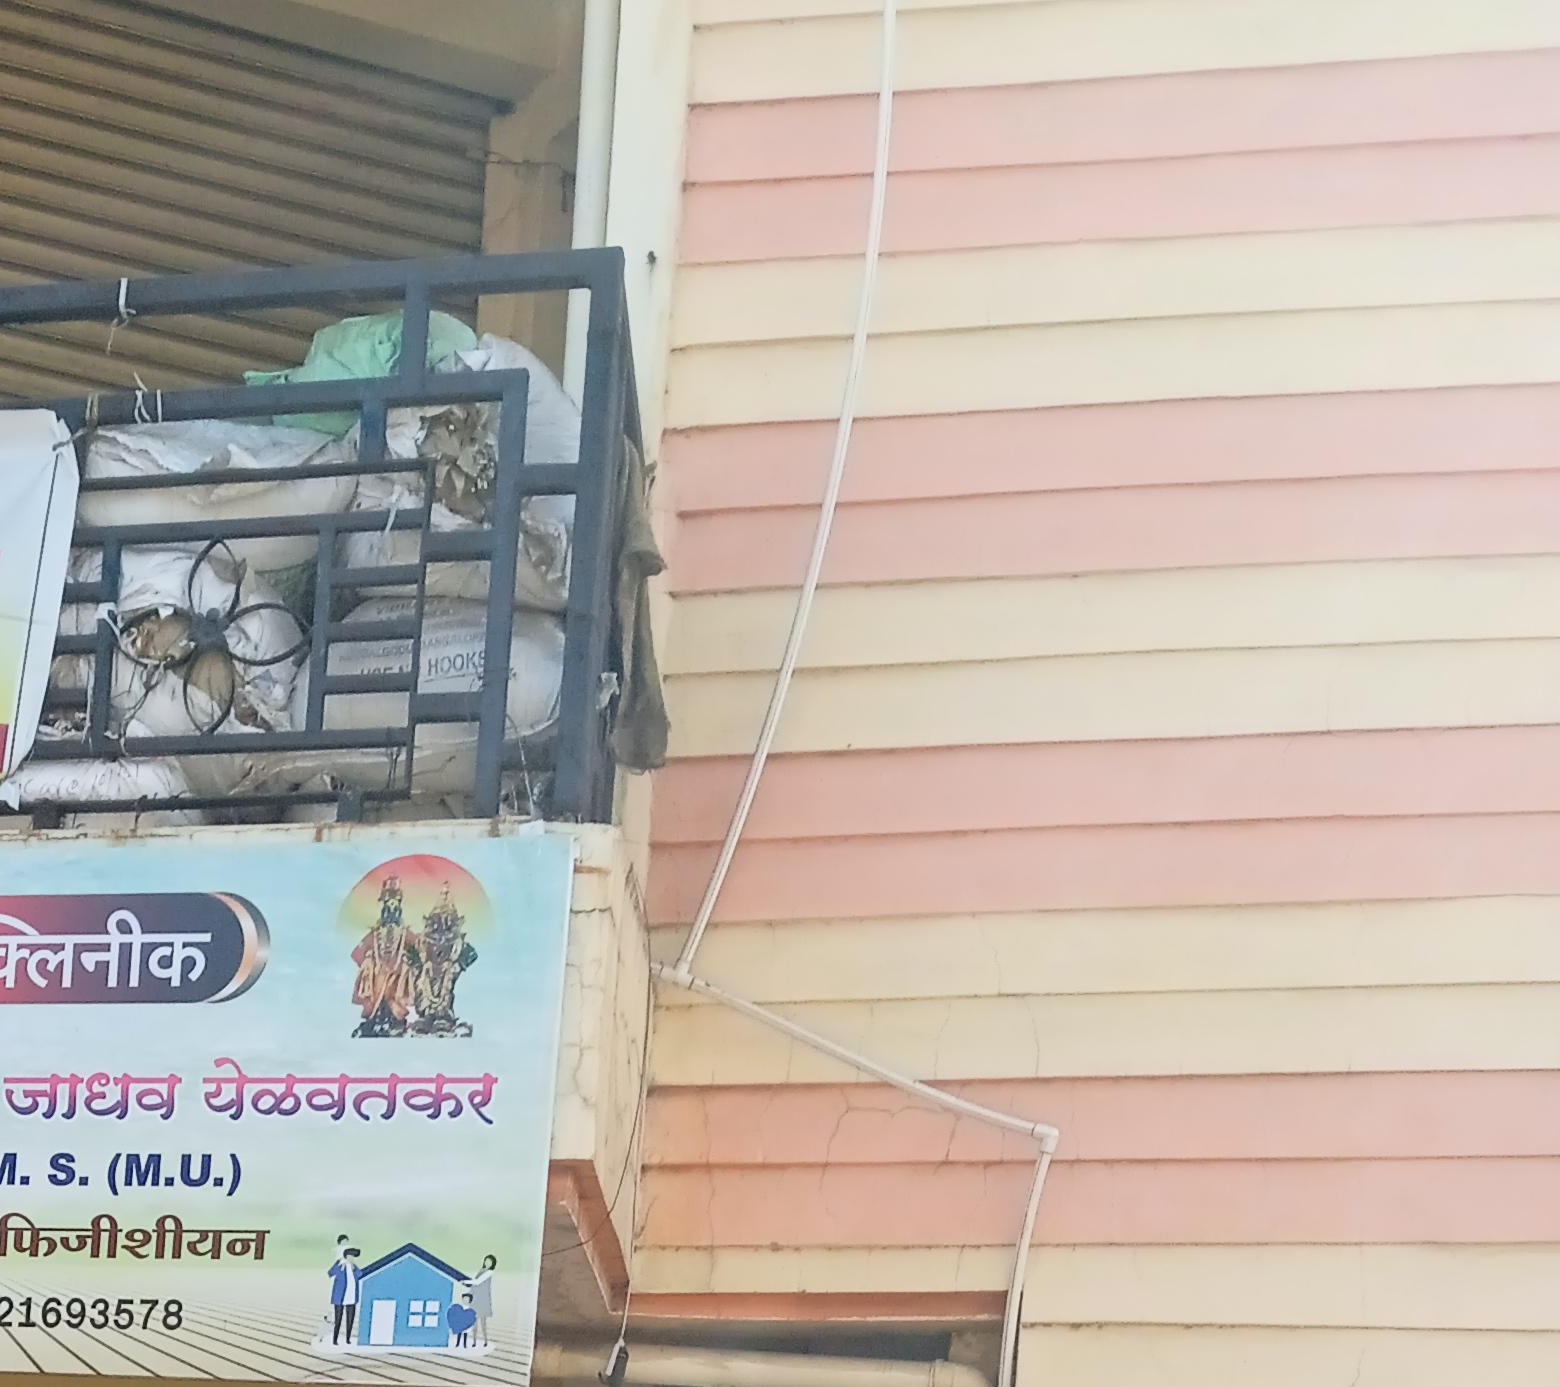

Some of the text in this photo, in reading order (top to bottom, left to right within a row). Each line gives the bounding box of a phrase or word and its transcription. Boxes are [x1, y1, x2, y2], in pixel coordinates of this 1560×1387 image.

[3, 1070, 183, 1121] जाधव
[202, 1056, 499, 1125] येळवतकर
[47, 1152, 90, 1188] S.
[107, 1152, 243, 1197] (M.U.)
